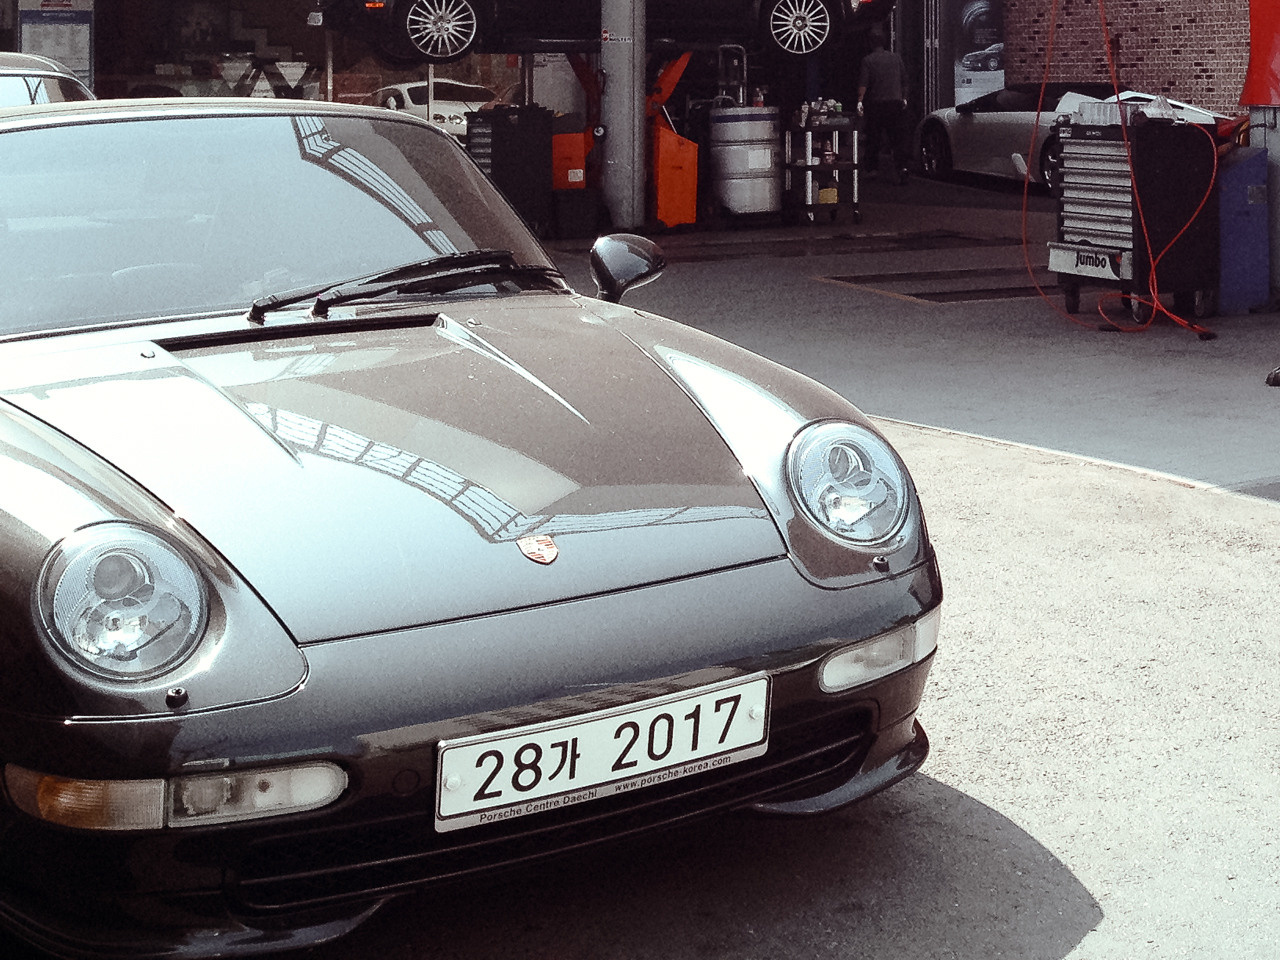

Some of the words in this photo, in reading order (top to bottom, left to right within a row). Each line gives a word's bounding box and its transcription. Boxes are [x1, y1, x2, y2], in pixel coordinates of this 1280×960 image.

[1075, 251, 1107, 268] Jumbo
[473, 737, 581, 801] 28가
[611, 694, 742, 772] 2017
[614, 755, 732, 792] www.porsche-korea.com
[479, 806, 522, 823] Porsche
[525, 799, 560, 813] Centre
